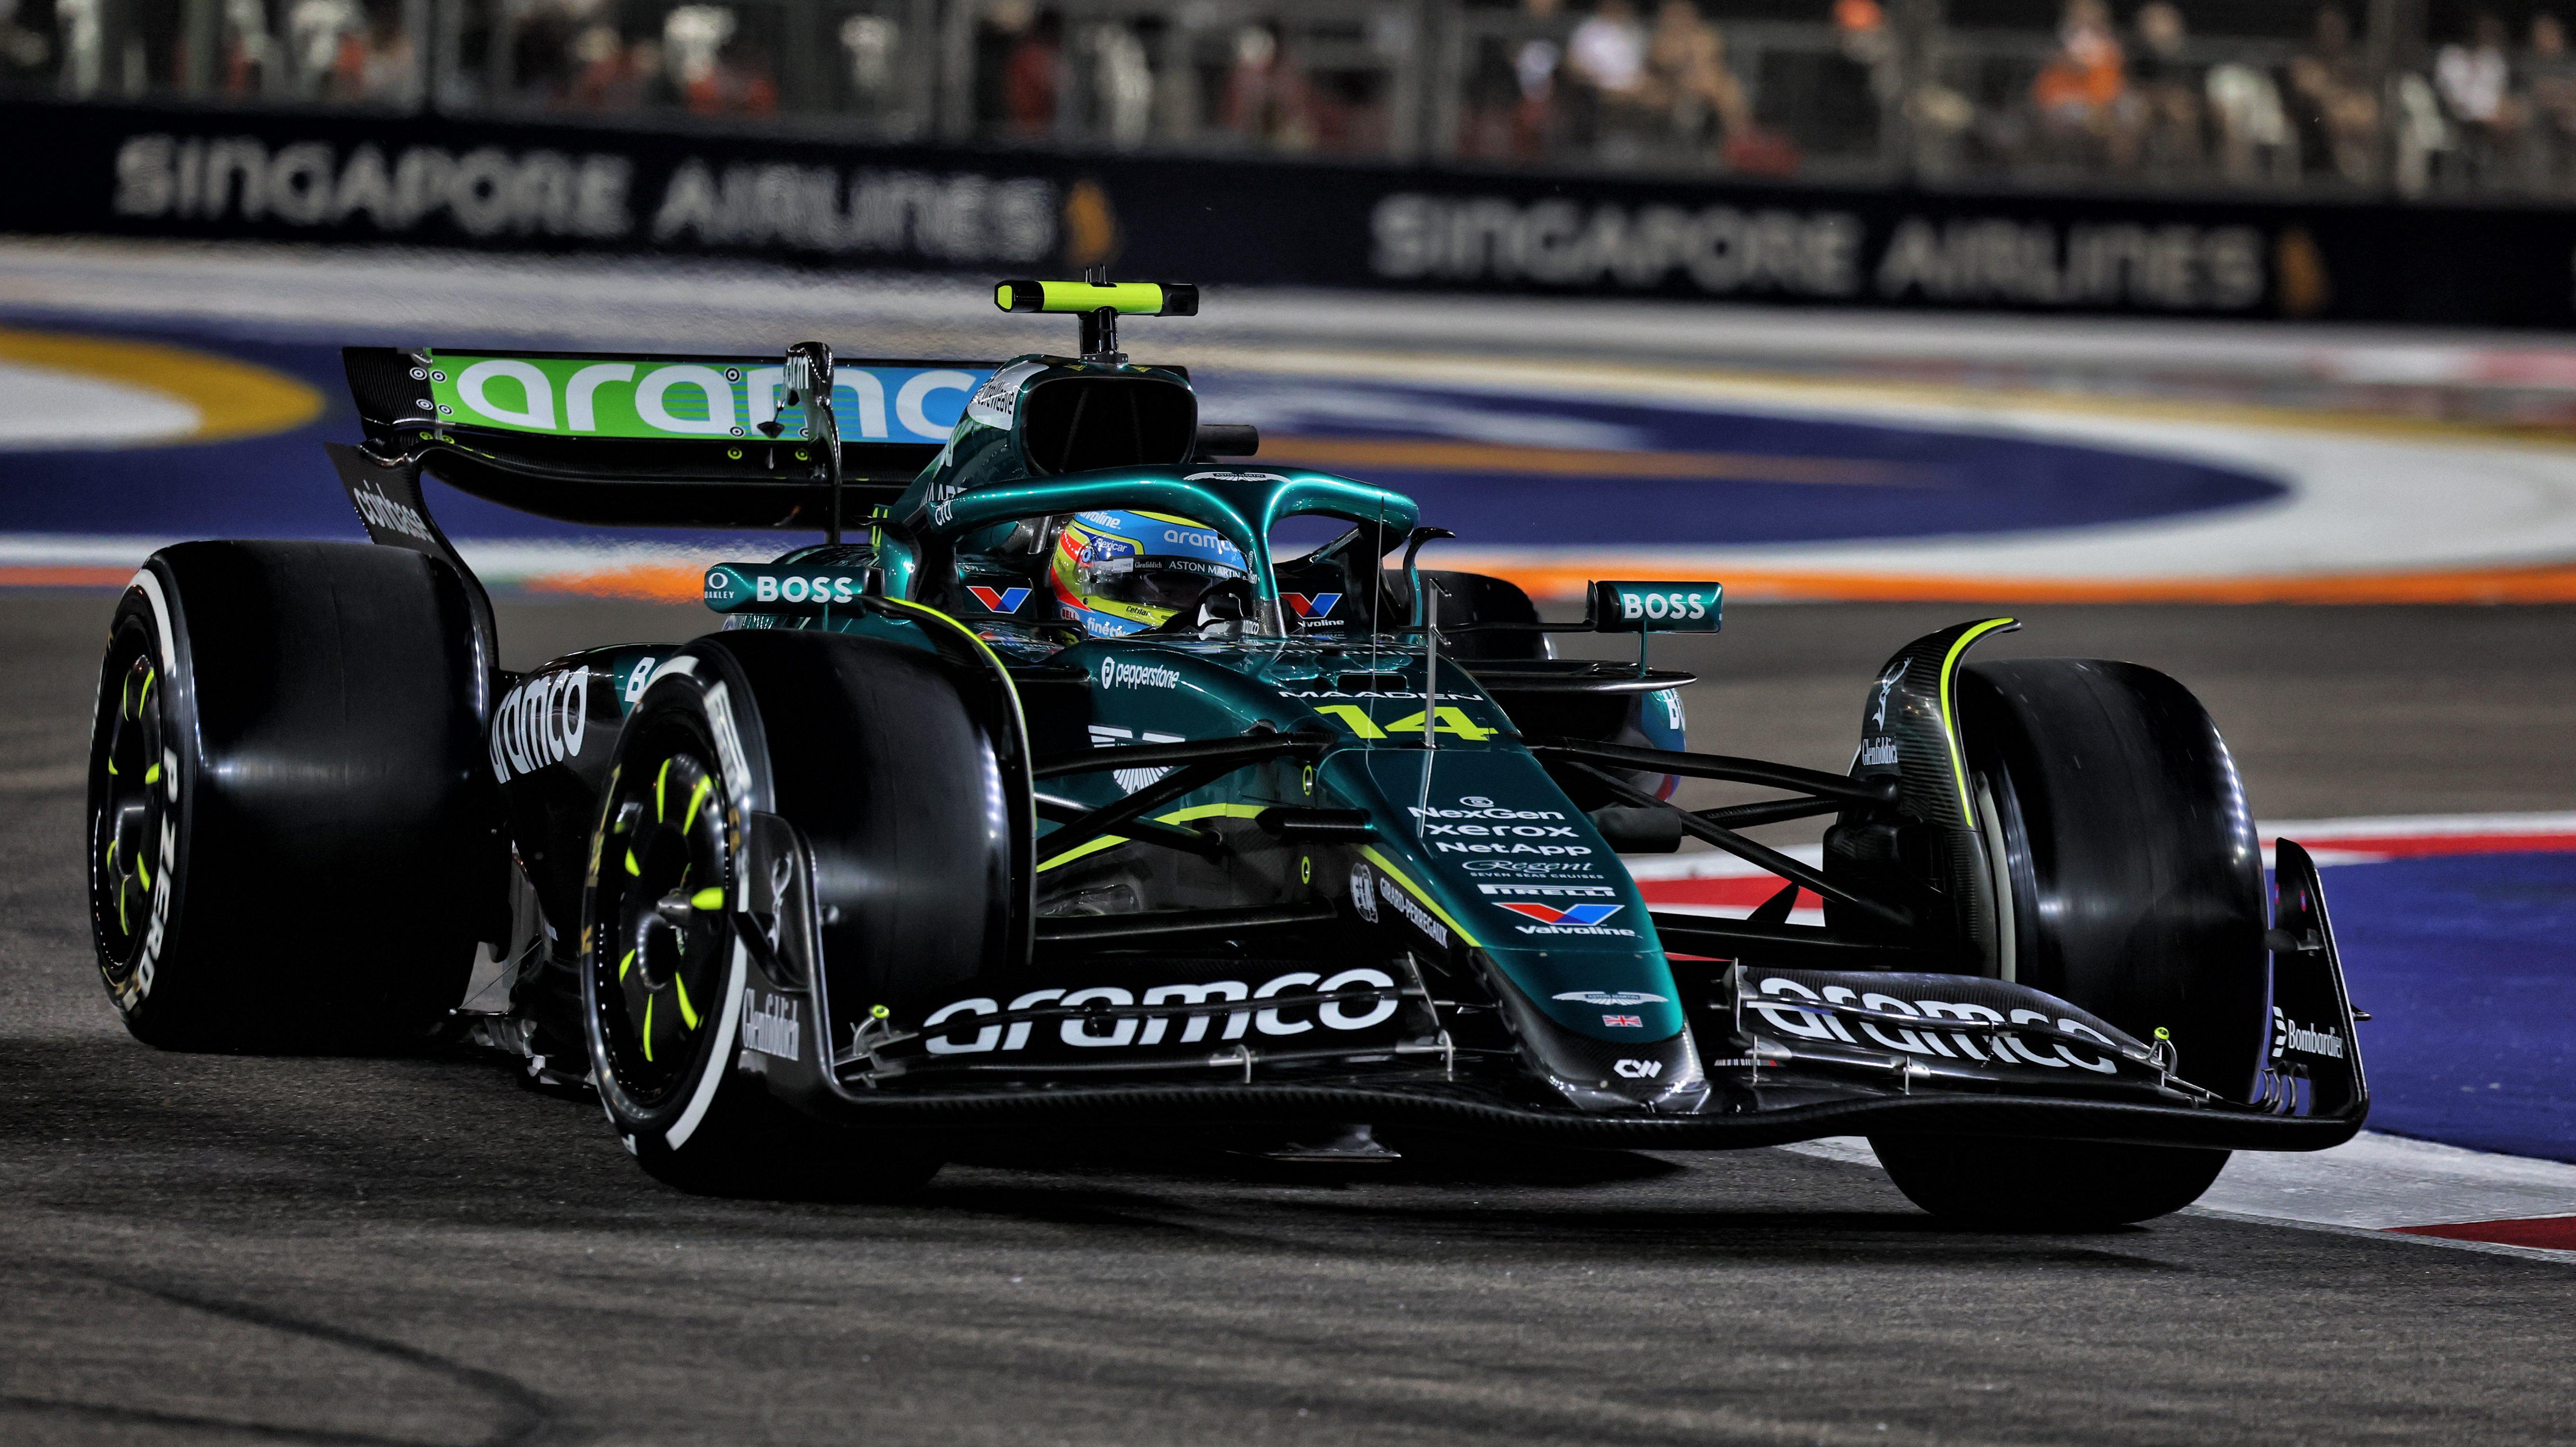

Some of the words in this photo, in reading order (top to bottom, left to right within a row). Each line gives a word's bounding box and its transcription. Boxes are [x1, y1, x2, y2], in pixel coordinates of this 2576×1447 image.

[117, 134, 632, 237] SINGAPORE
[654, 159, 1053, 261] AIRLINES
[1373, 195, 1859, 294] SINGAPORE
[1877, 216, 2261, 309] AIRLINES
[457, 359, 977, 439] aramc
[354, 479, 435, 541] coinbase
[1169, 561, 1205, 572] ASTON
[1208, 565, 1240, 578] MARTIN
[757, 576, 853, 603] BOSS
[1126, 606, 1150, 616] Cetilar
[1623, 593, 1705, 620] BOSS
[1116, 664, 1179, 690] pepperstone
[1278, 691, 1484, 701] MAADEN
[1314, 705, 1499, 741] 14
[165, 747, 178, 803] P
[1407, 806, 1565, 820] NexGen
[1424, 823, 1579, 838] xerox
[1436, 841, 1592, 856] NetApp
[1462, 860, 1594, 874] Regent
[1477, 884, 1616, 896] PIRELLI
[138, 810, 176, 1000] ZERO
[1515, 925, 1636, 938] Valvoline
[923, 967, 1395, 1054] aramco
[1760, 977, 2117, 1074] aramco
